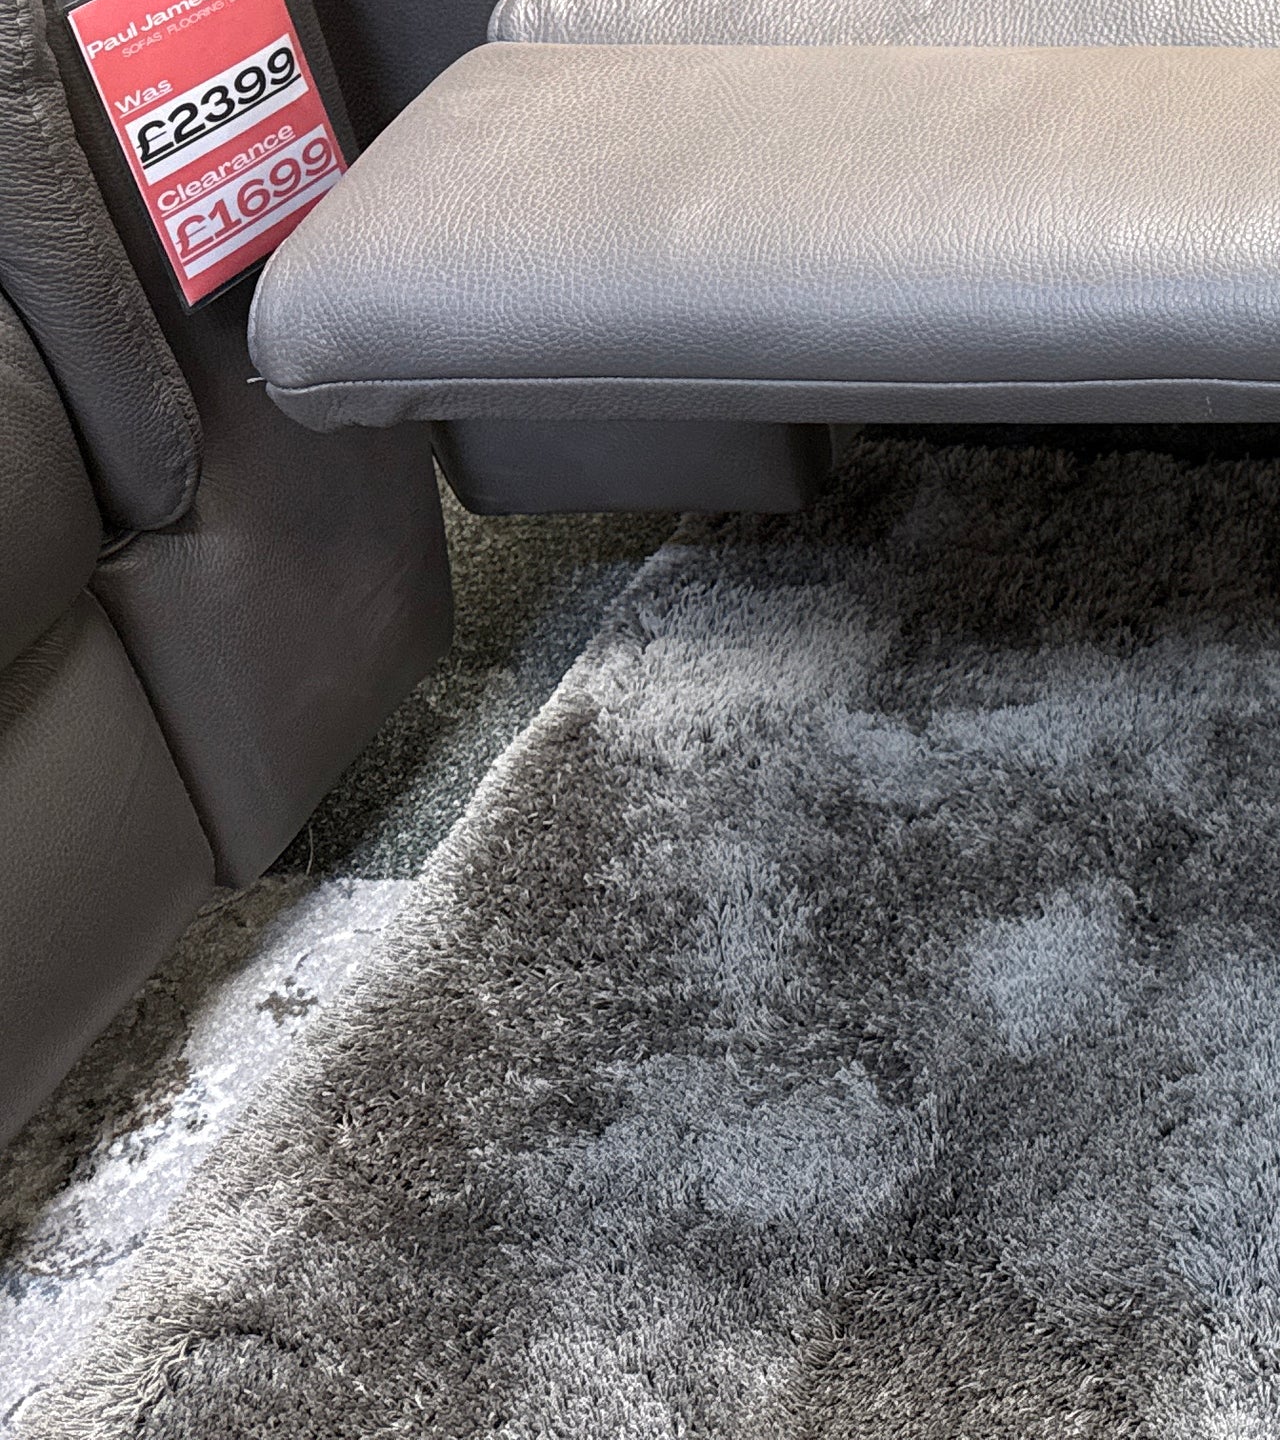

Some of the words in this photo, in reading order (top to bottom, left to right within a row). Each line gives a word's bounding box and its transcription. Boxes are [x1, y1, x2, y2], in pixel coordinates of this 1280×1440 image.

[86, 22, 138, 59] Paul
[121, 31, 163, 58] SOFAS
[166, 0, 225, 35] FLOORING
[114, 79, 173, 115] Was
[136, 46, 296, 159] £2399
[156, 123, 295, 212] Clearance
[175, 137, 333, 259] £1699
